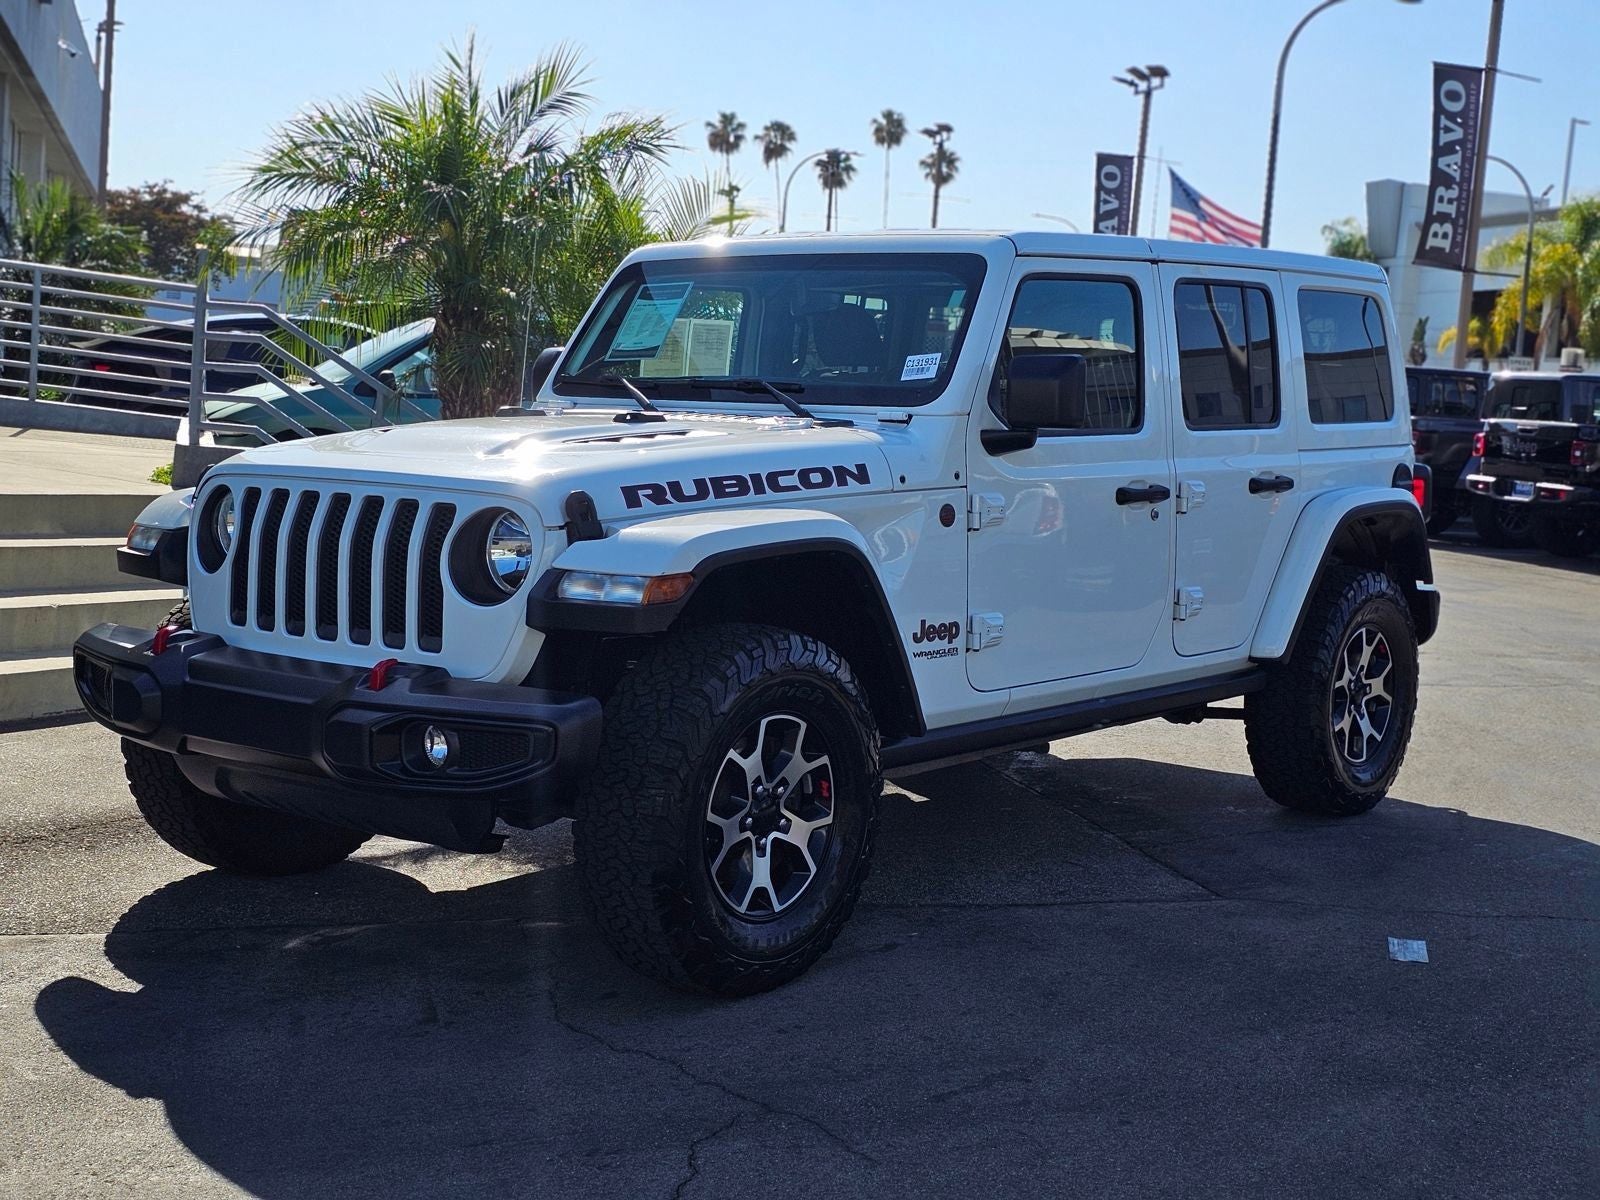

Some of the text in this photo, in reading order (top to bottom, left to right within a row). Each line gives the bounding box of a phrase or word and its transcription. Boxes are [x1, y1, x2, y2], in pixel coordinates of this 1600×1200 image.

[1425, 80, 1466, 253] BRAVO
[906, 357, 938, 368] C131931
[620, 463, 871, 509] RUBICON
[912, 619, 960, 644] Jeep
[912, 647, 959, 658] WRANGLER
